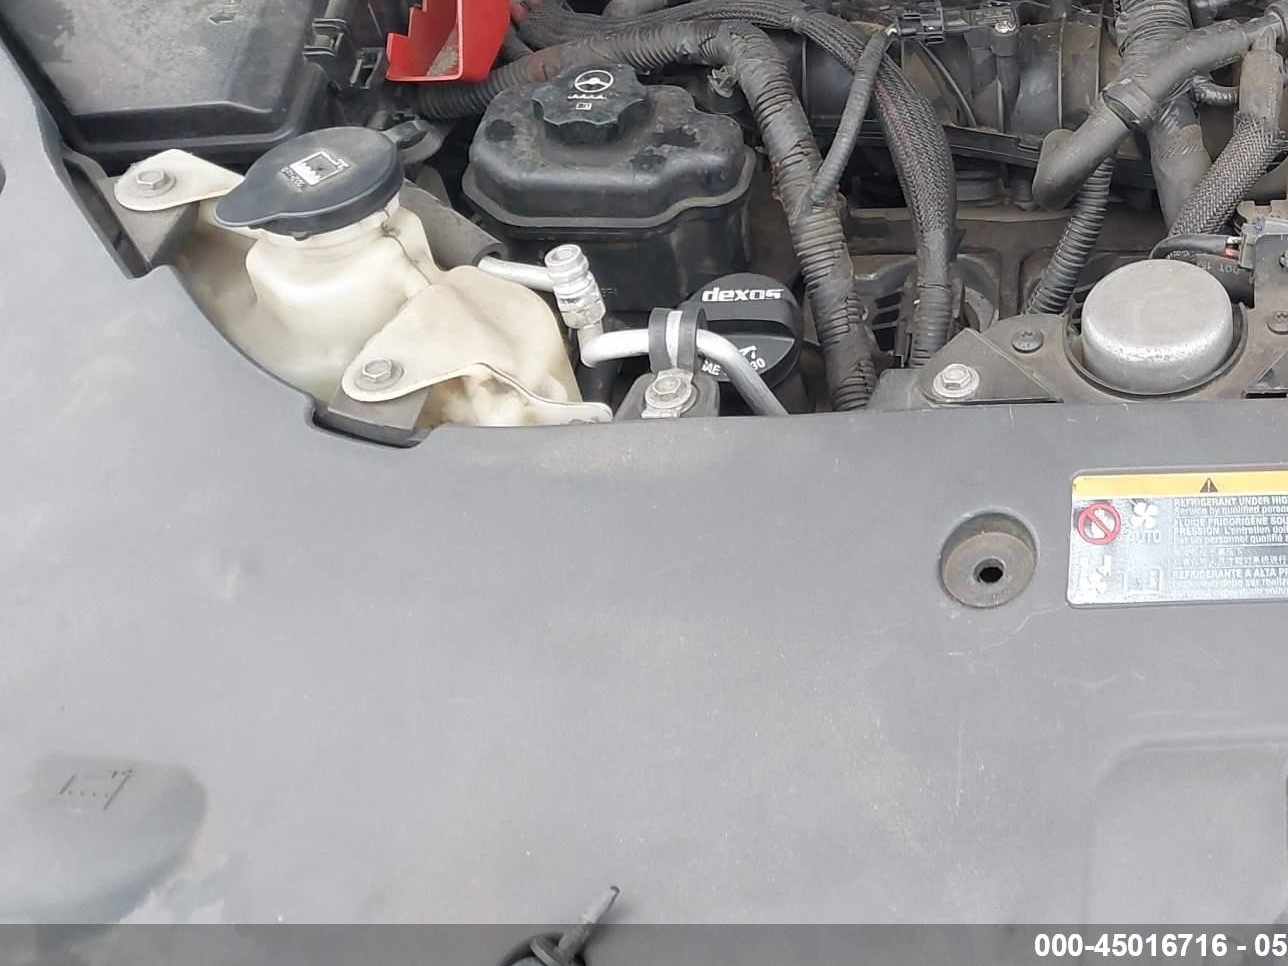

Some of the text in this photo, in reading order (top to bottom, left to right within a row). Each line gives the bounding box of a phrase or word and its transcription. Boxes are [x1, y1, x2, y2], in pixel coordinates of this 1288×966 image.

[702, 287, 784, 302] dexos
[1238, 496, 1270, 506] UNDER
[1253, 567, 1277, 578] ALTA
